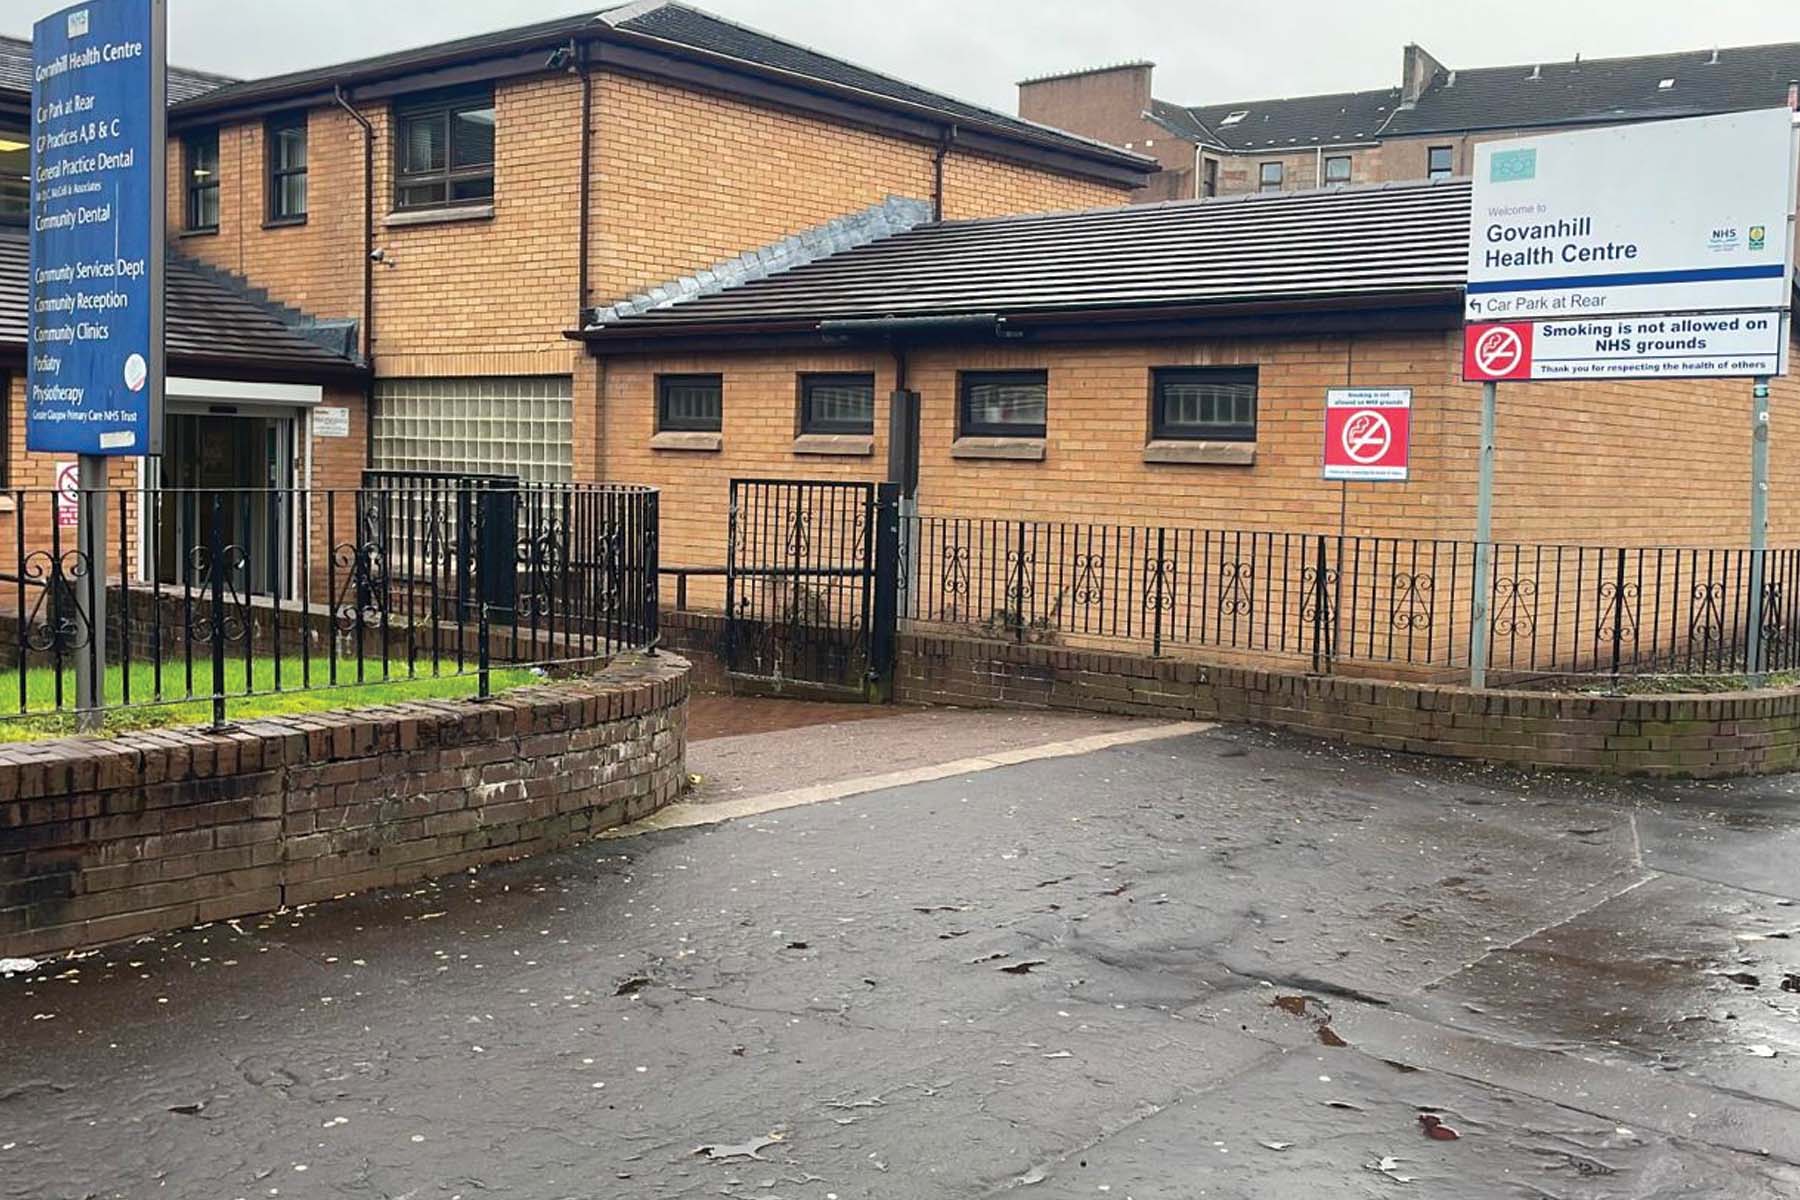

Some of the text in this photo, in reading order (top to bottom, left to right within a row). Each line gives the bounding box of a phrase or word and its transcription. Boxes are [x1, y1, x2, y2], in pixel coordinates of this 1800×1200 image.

[69, 46, 100, 71] Health
[103, 41, 142, 62] Centre
[74, 94, 95, 111] Rear
[99, 120, 108, 139] &
[111, 118, 120, 137] C
[62, 155, 96, 176] Practice
[98, 147, 134, 170] Dental
[35, 203, 110, 231] Community Dental
[1488, 203, 1546, 217] Welcome to
[1486, 216, 1591, 243] Govanhill
[1712, 228, 1737, 239] NHS
[1485, 242, 1638, 268] Health Centre
[35, 258, 144, 285] Community Services Dept
[34, 290, 128, 315] Community Reception
[1487, 293, 1607, 312] Car Park at Rear
[34, 321, 109, 345] Community Clinics
[1543, 318, 1768, 338] Smoking is not allowed on
[1595, 337, 1707, 353] NHS grounds
[1540, 360, 1766, 374] Thank you for respecting the health of others
[33, 384, 84, 406] Physiotherapy
[88, 409, 103, 421] Care
[104, 409, 119, 421] NHS
[120, 410, 137, 422] Trust
